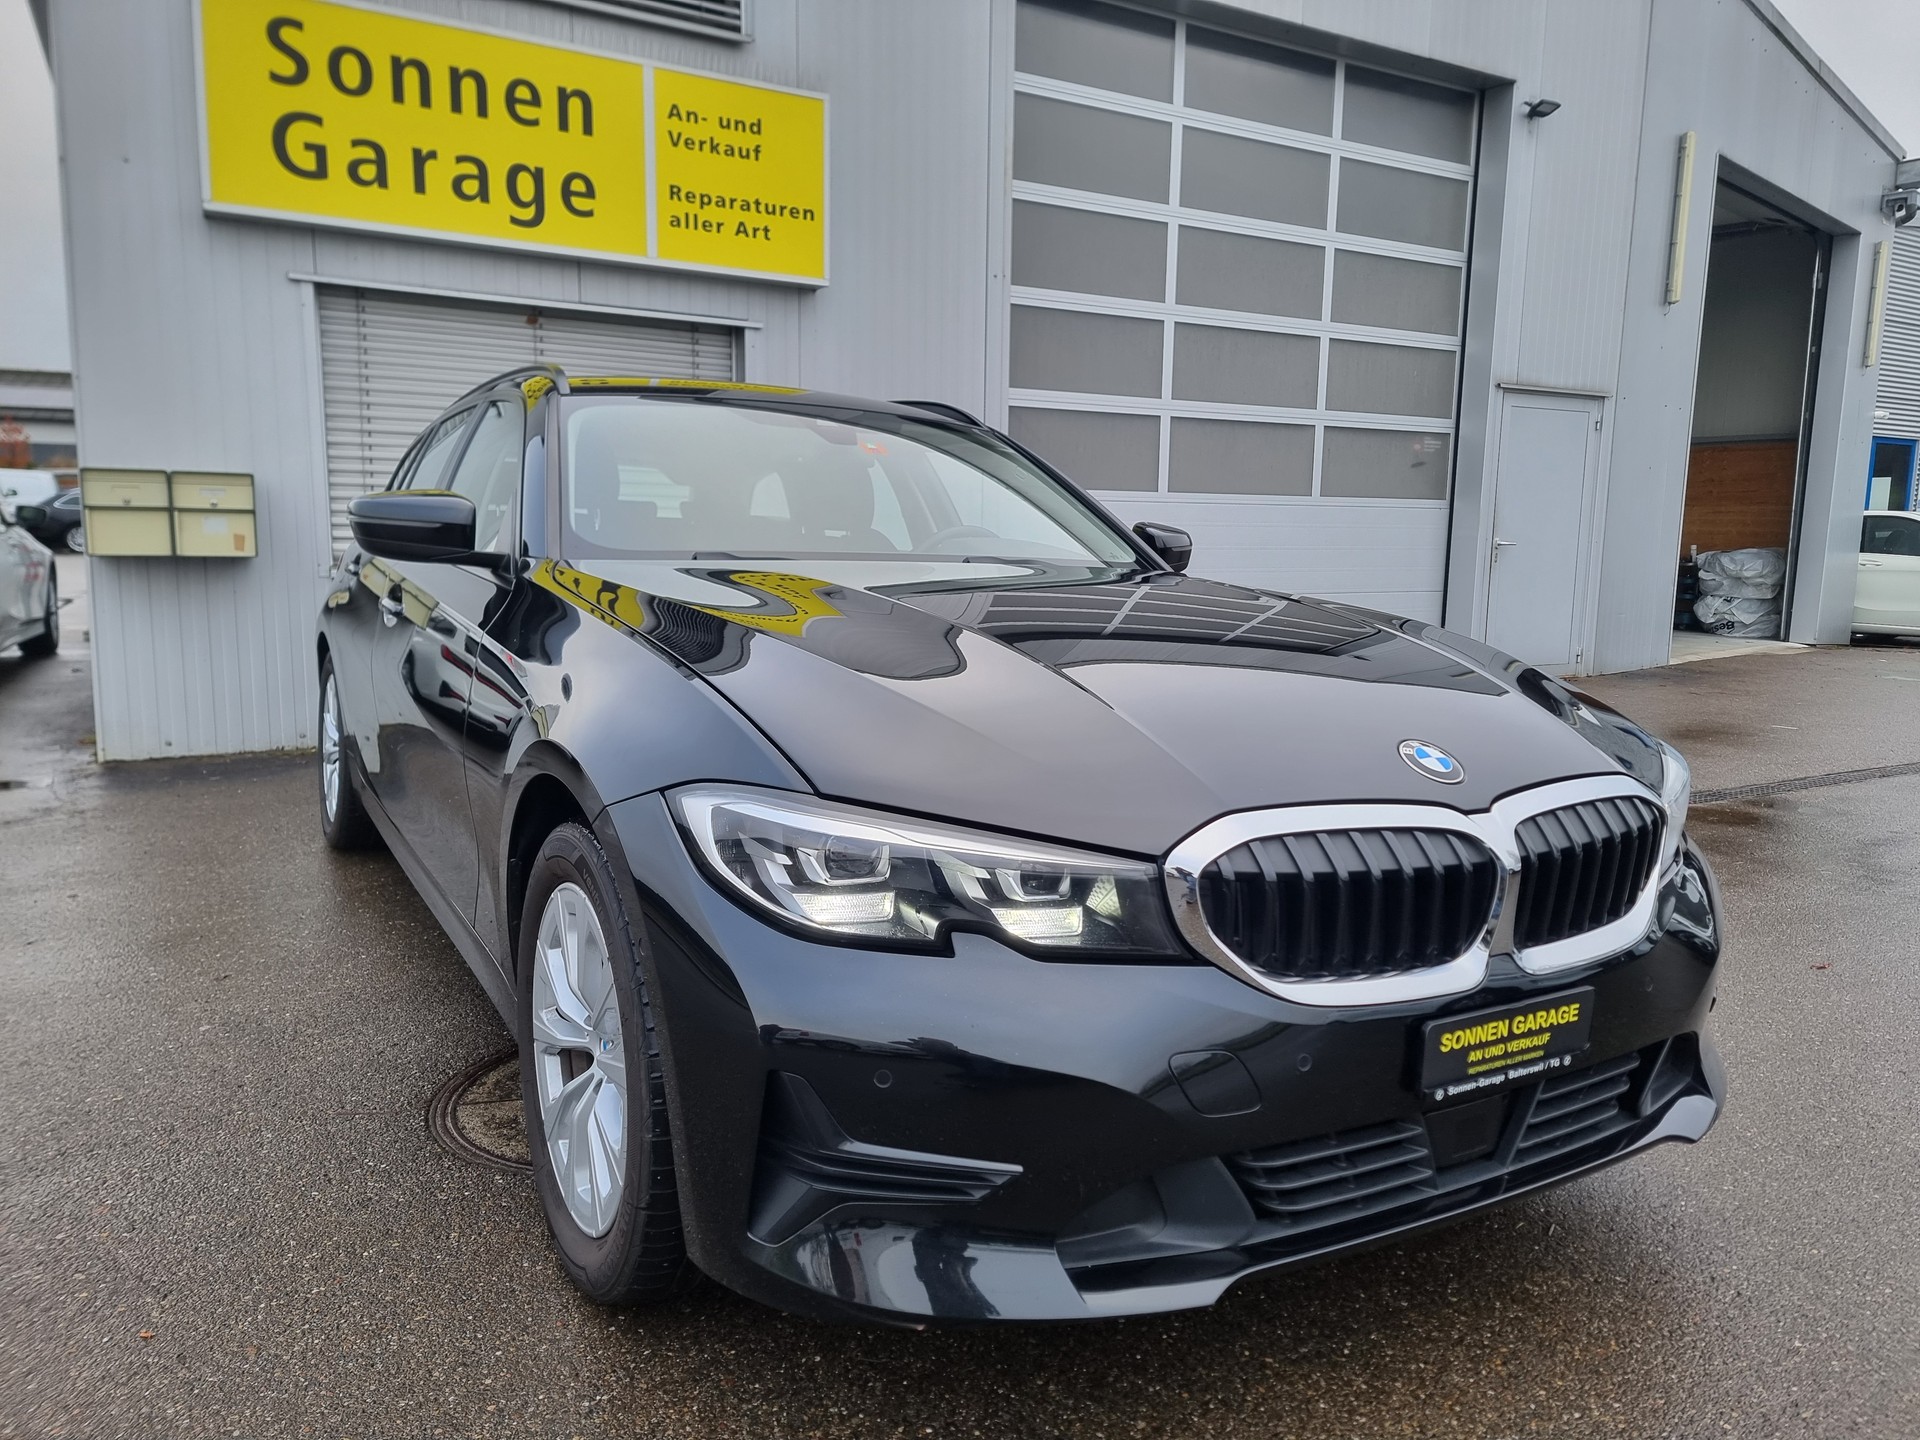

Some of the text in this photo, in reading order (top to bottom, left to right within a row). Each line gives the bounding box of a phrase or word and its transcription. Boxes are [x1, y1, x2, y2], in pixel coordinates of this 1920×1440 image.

[265, 16, 594, 137] Sonnen
[667, 103, 762, 136] An- und
[667, 130, 762, 162] Verkauf
[271, 111, 597, 229] Garage
[669, 184, 815, 221] Reparaturen
[669, 212, 771, 241] aller Art
[1440, 1003, 1580, 1053] SONNEN GARAGE
[1467, 1032, 1551, 1064] AN UND VERKAUF
[1447, 1073, 1506, 1096] Sonnen-Garage
[1550, 1058, 1561, 1069] TG
